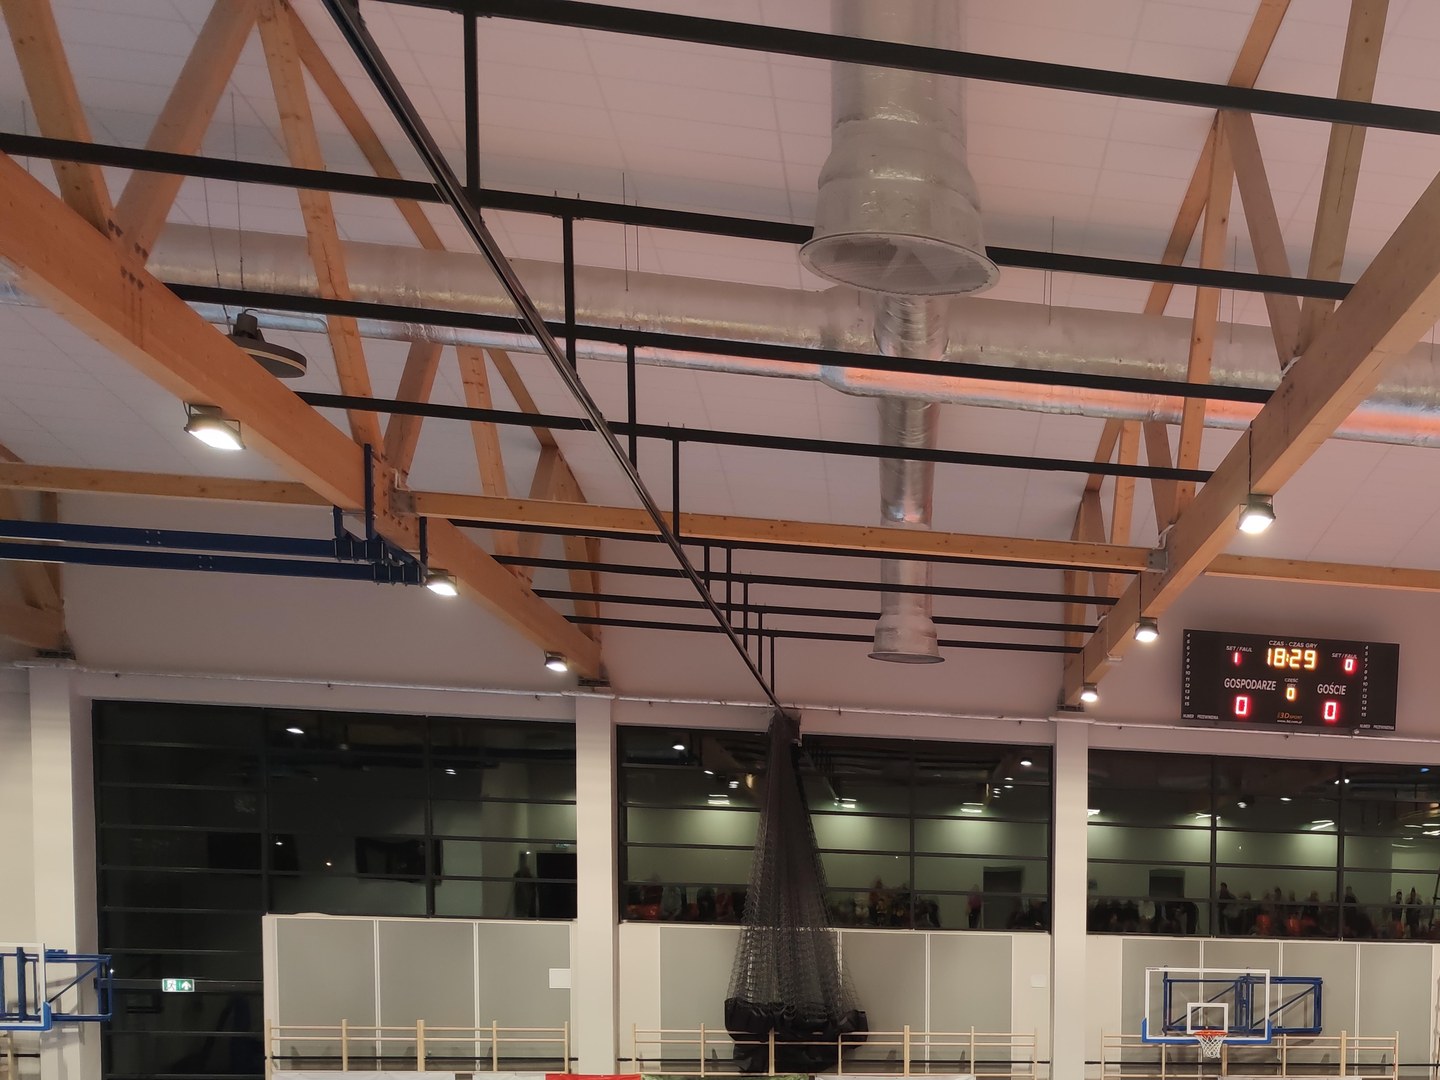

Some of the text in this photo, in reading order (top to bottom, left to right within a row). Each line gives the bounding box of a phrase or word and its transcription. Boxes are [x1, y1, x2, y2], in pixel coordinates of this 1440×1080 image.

[1267, 647, 1316, 669] 18:29
[1344, 659, 1354, 671] 0
[1224, 678, 1277, 691] GOSPODARZE
[1317, 682, 1347, 695] GOŚCIE
[1286, 687, 1296, 700] 0
[1235, 696, 1248, 715] 0
[1324, 702, 1337, 720] 0
